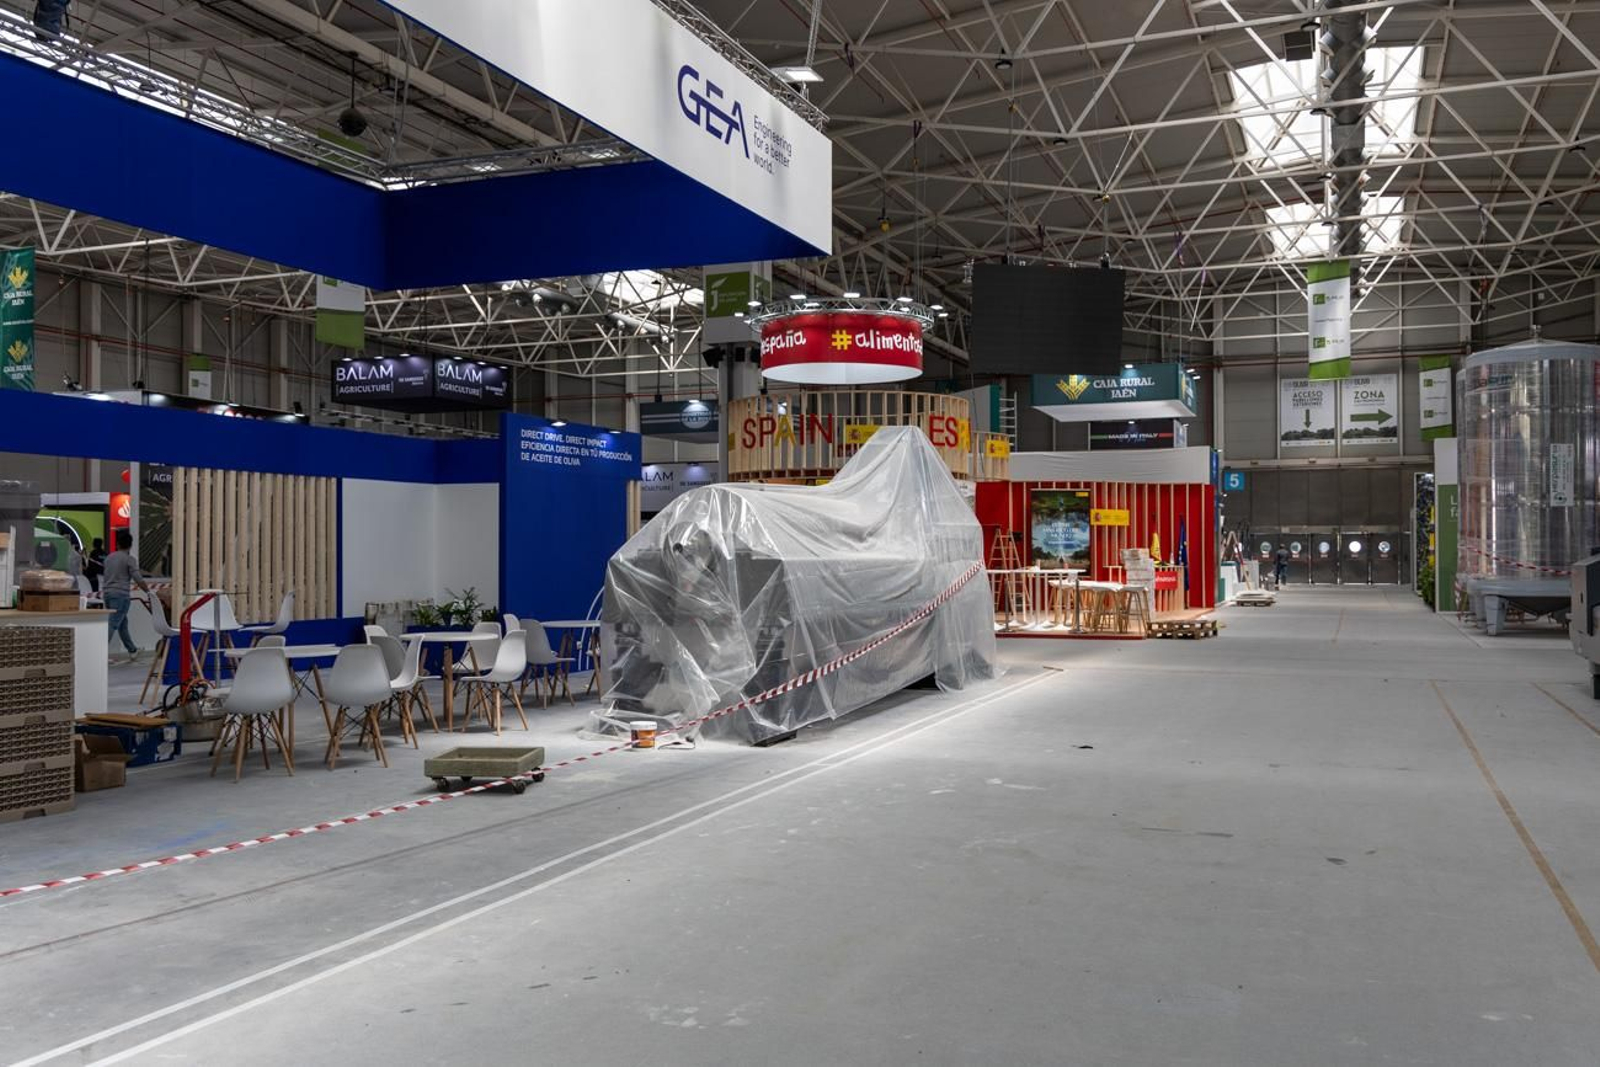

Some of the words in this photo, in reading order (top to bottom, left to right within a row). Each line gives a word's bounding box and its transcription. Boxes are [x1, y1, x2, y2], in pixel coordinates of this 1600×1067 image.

[677, 64, 750, 159] GEA
[754, 115, 792, 157] Engineering
[754, 132, 764, 149] for
[771, 145, 790, 168] better
[336, 364, 394, 382] BALAM
[437, 362, 482, 384] BALAM
[339, 383, 391, 394] AGRICULTURE
[439, 383, 481, 396] AGRICULTURE
[1120, 377, 1155, 388] RURAL
[1293, 390, 1323, 398] ACCESO
[1354, 390, 1385, 400] ZONA
[521, 429, 544, 440] DIRECT
[565, 435, 586, 445] DIRECT
[587, 438, 607, 448] IMPACT
[742, 413, 833, 449] SPAIN
[521, 441, 555, 452] EFICIENCIA
[555, 444, 580, 455] DIRECTA
[580, 448, 589, 456] EN
[521, 452, 530, 461] DE
[531, 453, 552, 463] ACEITE
[553, 456, 562, 465] DE
[564, 457, 580, 466] OLIVA
[152, 473, 173, 483] AGR
[640, 471, 674, 482] LAM
[1230, 473, 1240, 488] 5
